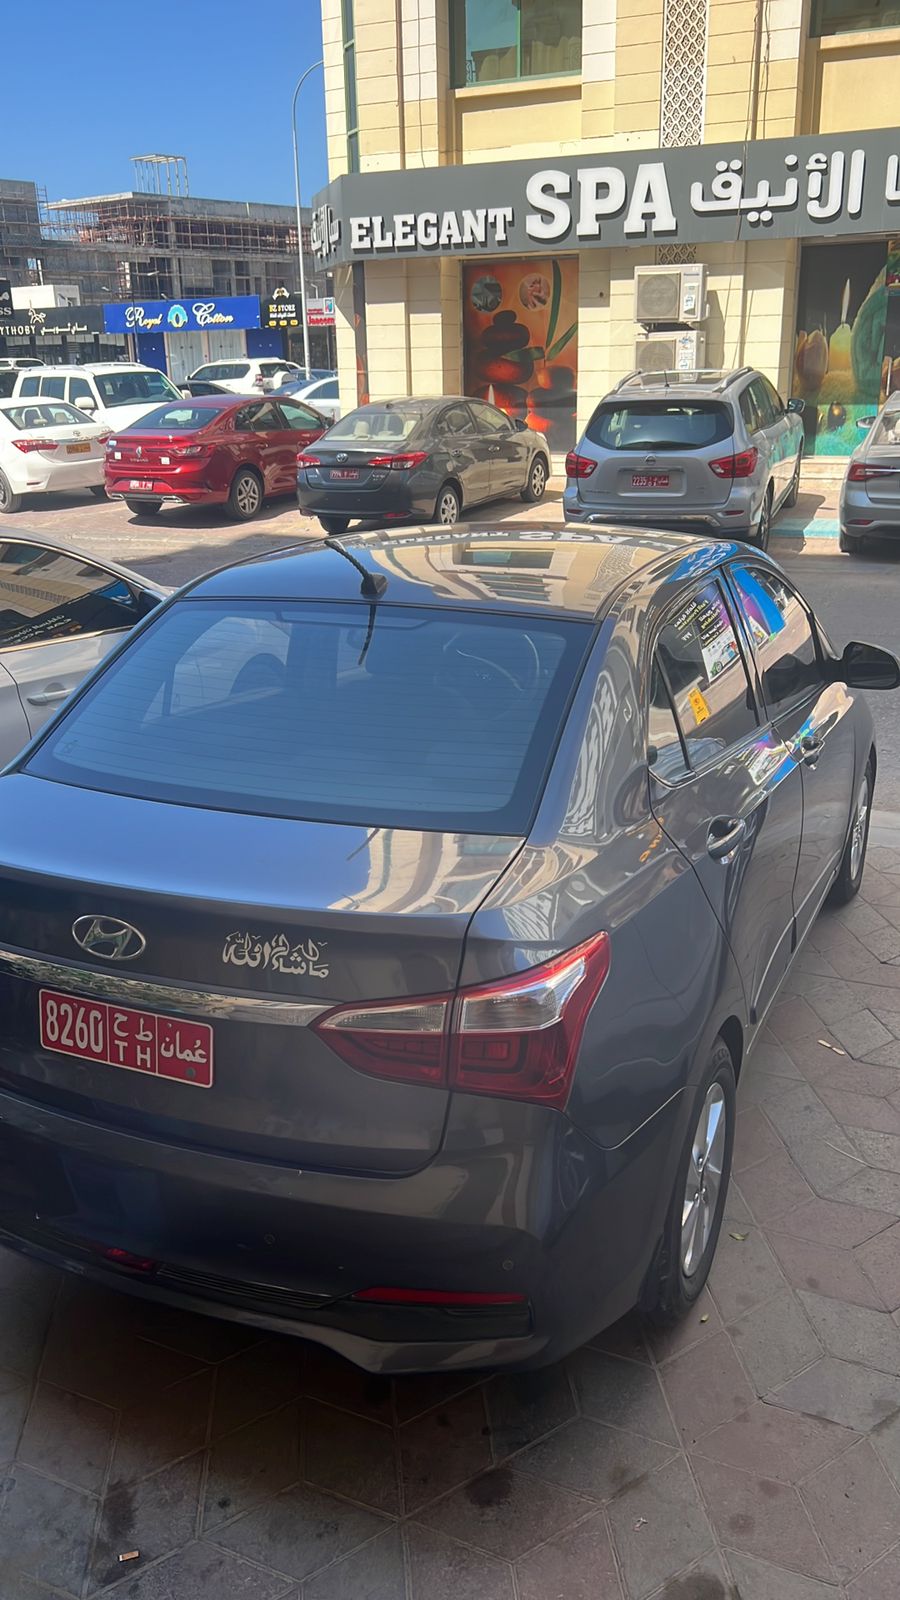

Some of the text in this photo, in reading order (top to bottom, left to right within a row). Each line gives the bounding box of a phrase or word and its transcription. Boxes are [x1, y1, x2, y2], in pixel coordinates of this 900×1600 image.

[350, 162, 677, 249] ELEGANT SPA
[691, 149, 865, 223] الأنيق
[125, 303, 234, 329] Royal Cotton
[46, 999, 104, 1053] 8260
